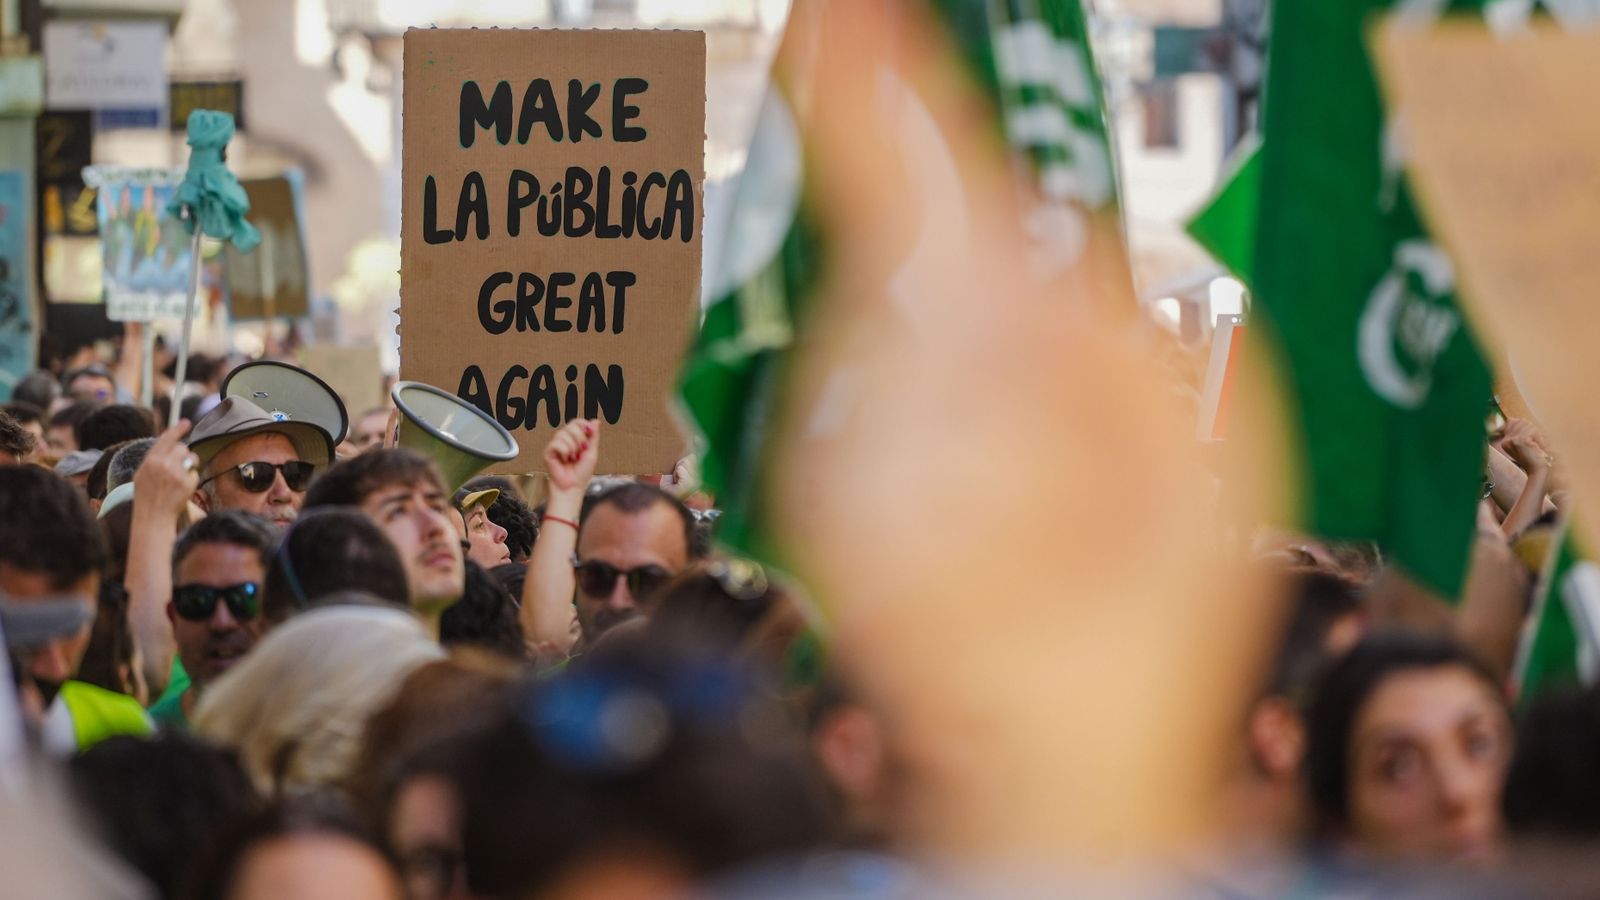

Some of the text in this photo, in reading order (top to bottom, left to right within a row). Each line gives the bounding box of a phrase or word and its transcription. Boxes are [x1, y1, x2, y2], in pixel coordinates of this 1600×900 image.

[459, 78, 649, 148] MAKE
[422, 171, 490, 244] LA
[477, 272, 636, 335] GREAT
